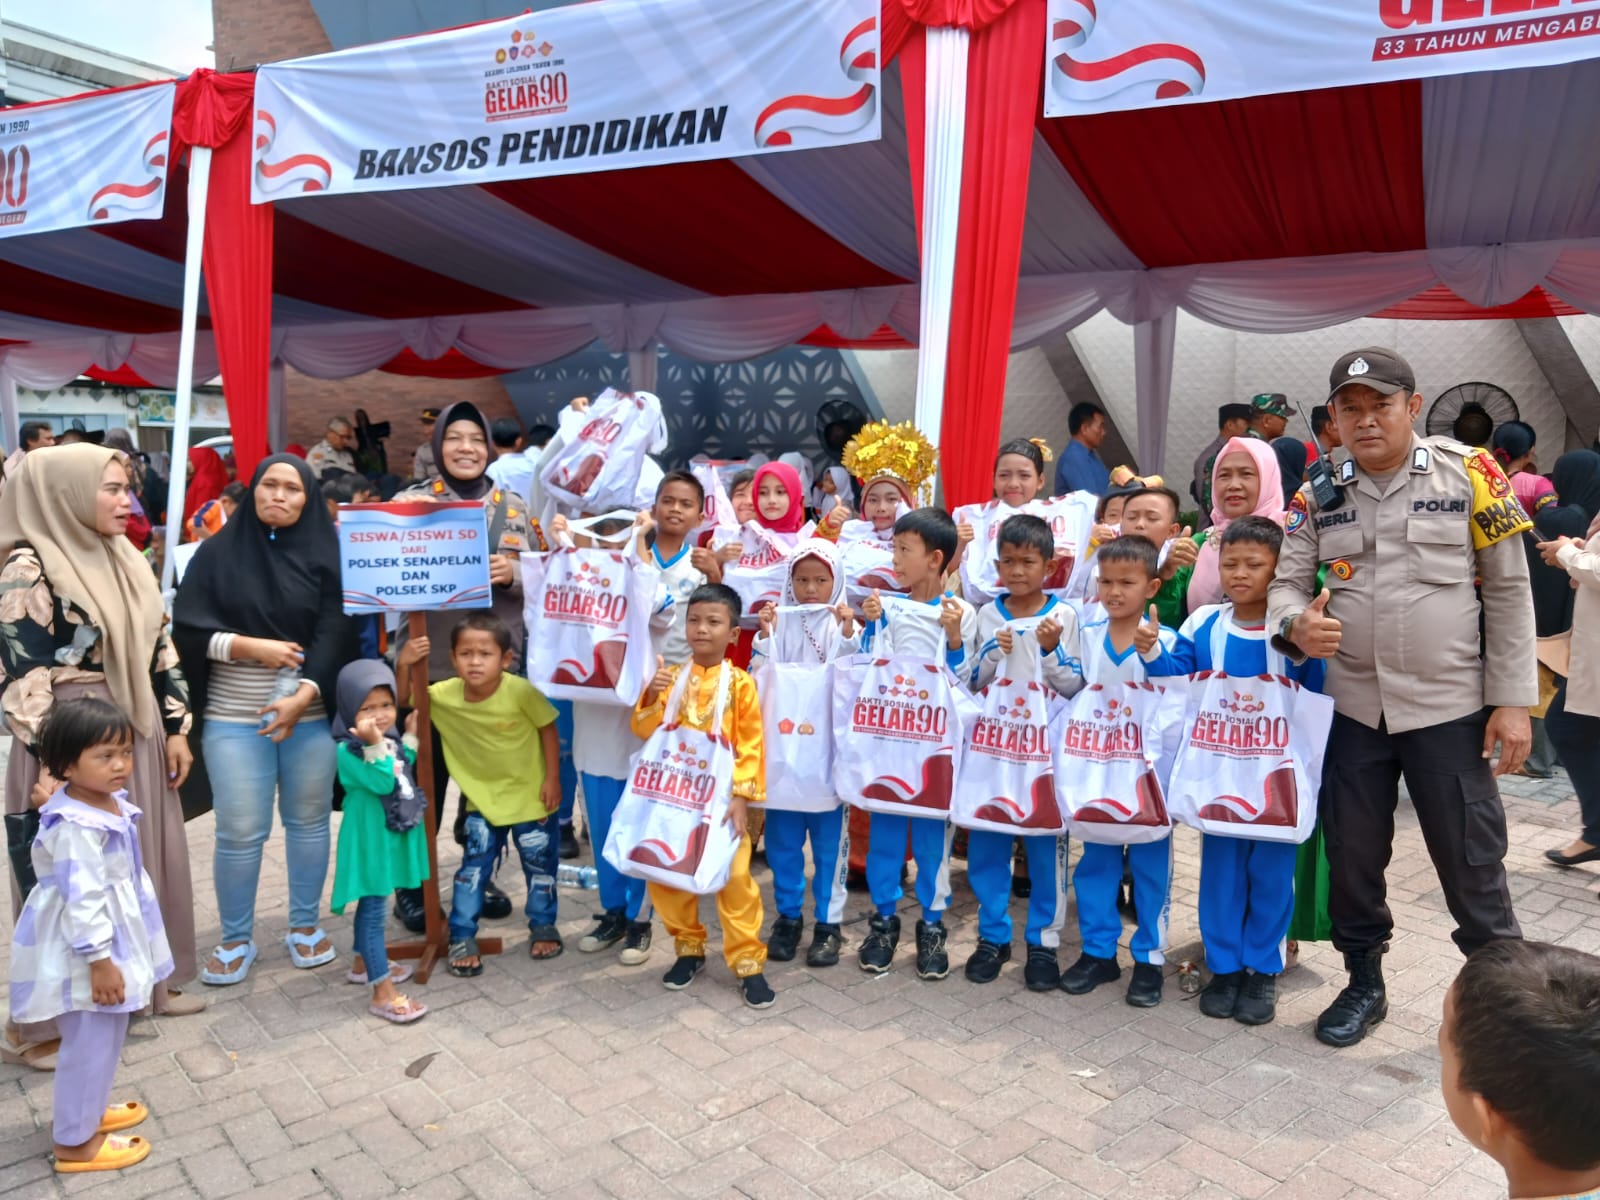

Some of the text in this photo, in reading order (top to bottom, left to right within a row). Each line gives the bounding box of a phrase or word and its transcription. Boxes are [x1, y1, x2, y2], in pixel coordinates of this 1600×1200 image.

[1380, 15, 1600, 56] 33 TAHUN MENGAB
[9, 119, 30, 134] 1990
[354, 105, 729, 180] BANSOS PENDIDIKAN
[1413, 500, 1466, 513] POLRI
[1314, 509, 1357, 530] HERLI
[349, 529, 478, 543] SISWA/SISWI SD
[401, 545, 428, 554] DARI
[348, 555, 482, 568] POLSEK SENAPELAN
[401, 571, 430, 581] DAN
[376, 584, 457, 596] POLSEK SKP
[883, 699, 916, 709] SOSIAL
